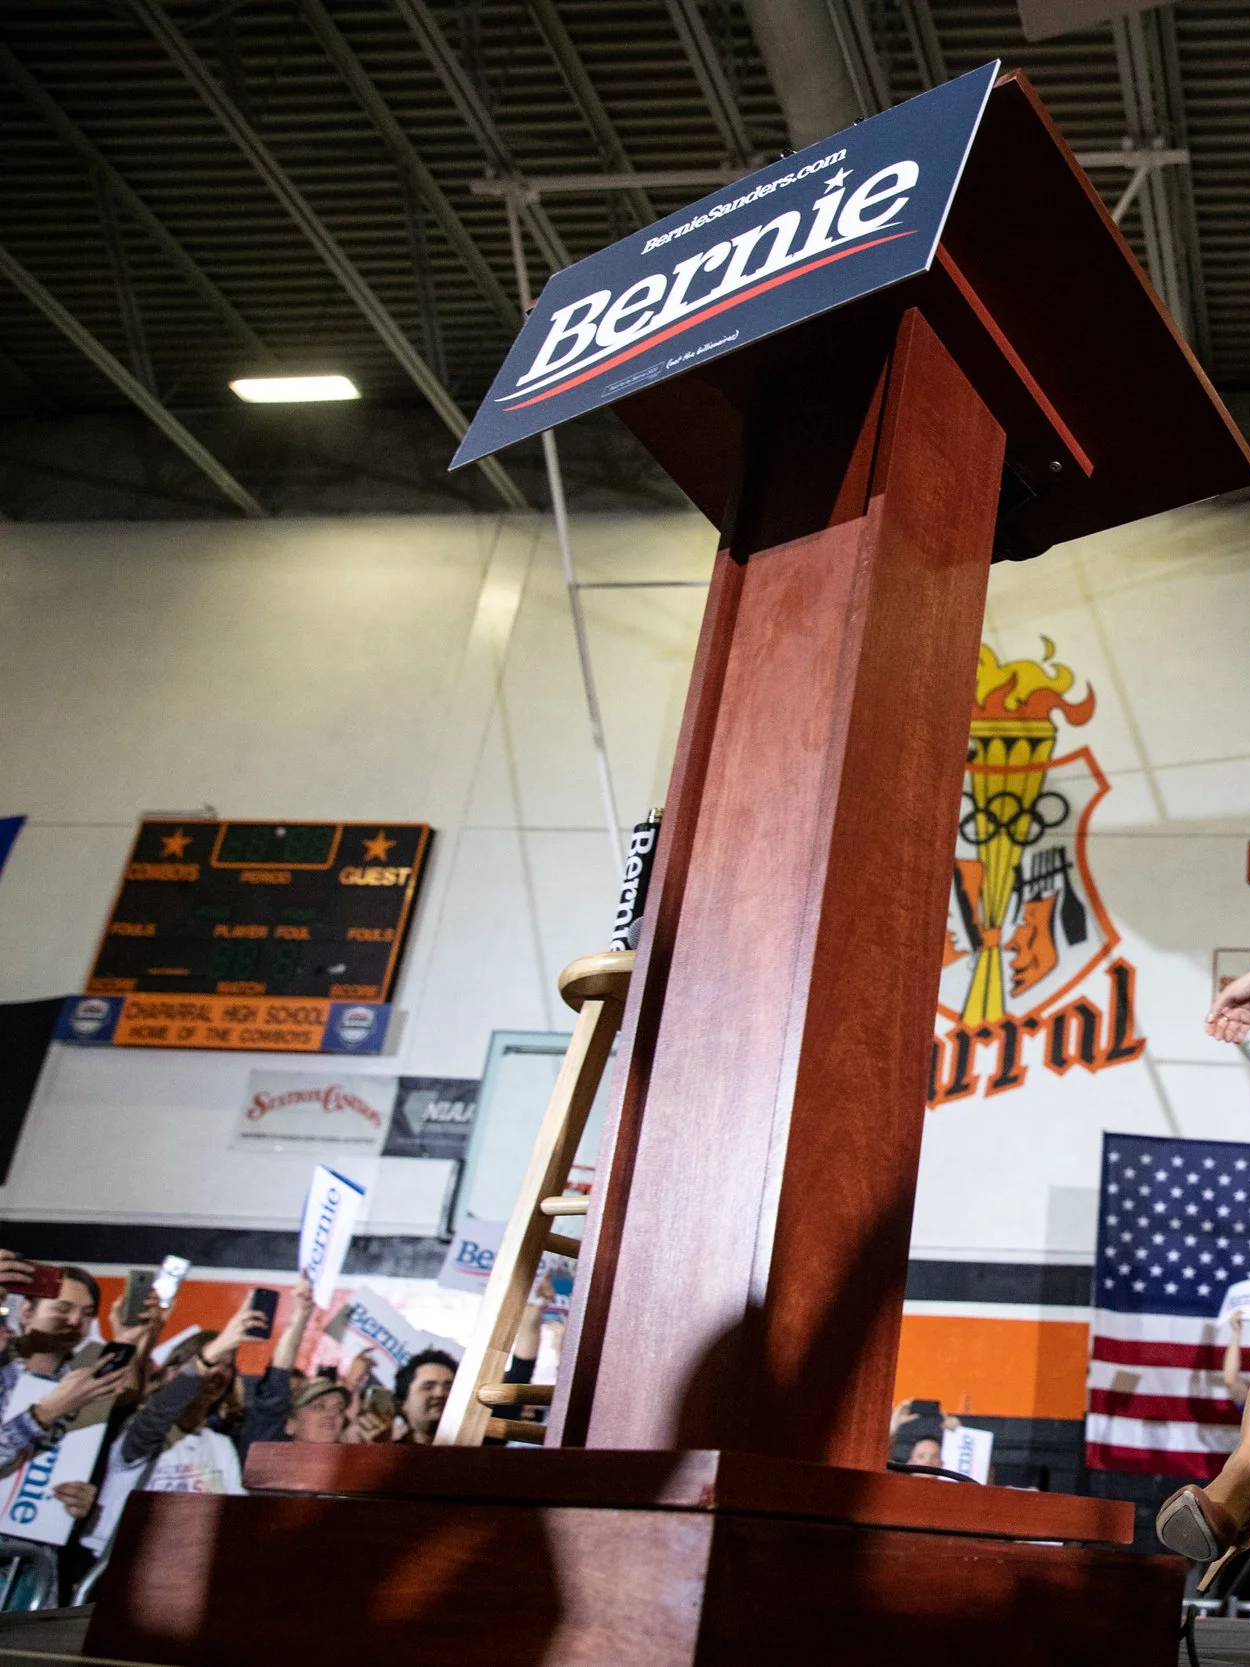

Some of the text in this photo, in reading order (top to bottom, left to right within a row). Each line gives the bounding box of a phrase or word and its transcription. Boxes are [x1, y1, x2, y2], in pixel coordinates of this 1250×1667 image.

[641, 148, 847, 255] BernieSanders.com
[516, 160, 919, 388] Bernie
[338, 866, 413, 887] GUEST
[10, 1414, 76, 1524] ernie
